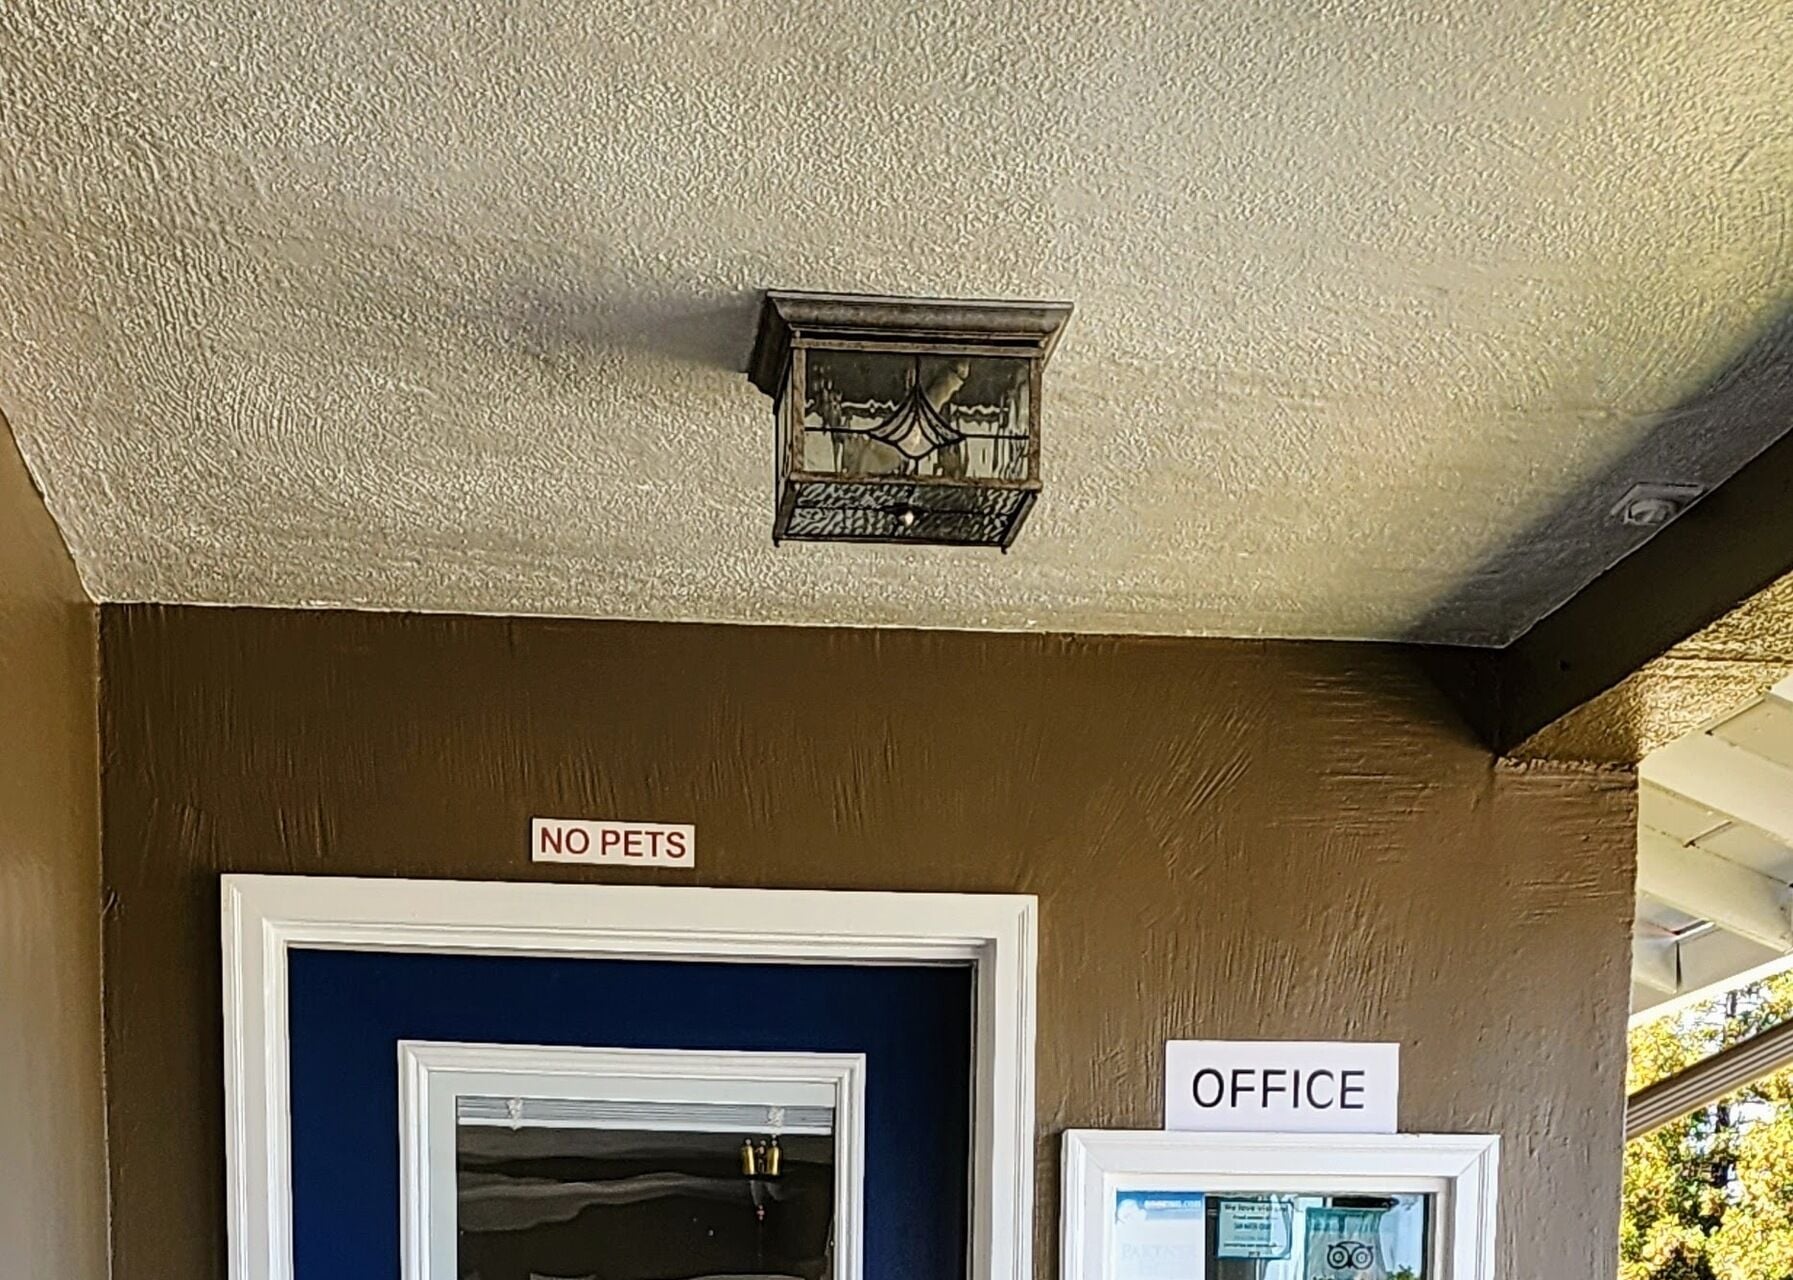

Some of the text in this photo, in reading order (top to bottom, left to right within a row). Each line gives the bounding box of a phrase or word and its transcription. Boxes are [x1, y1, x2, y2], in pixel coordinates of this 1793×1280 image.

[541, 827, 687, 859] NO PETS
[1192, 1067, 1366, 1109] OFFICE
